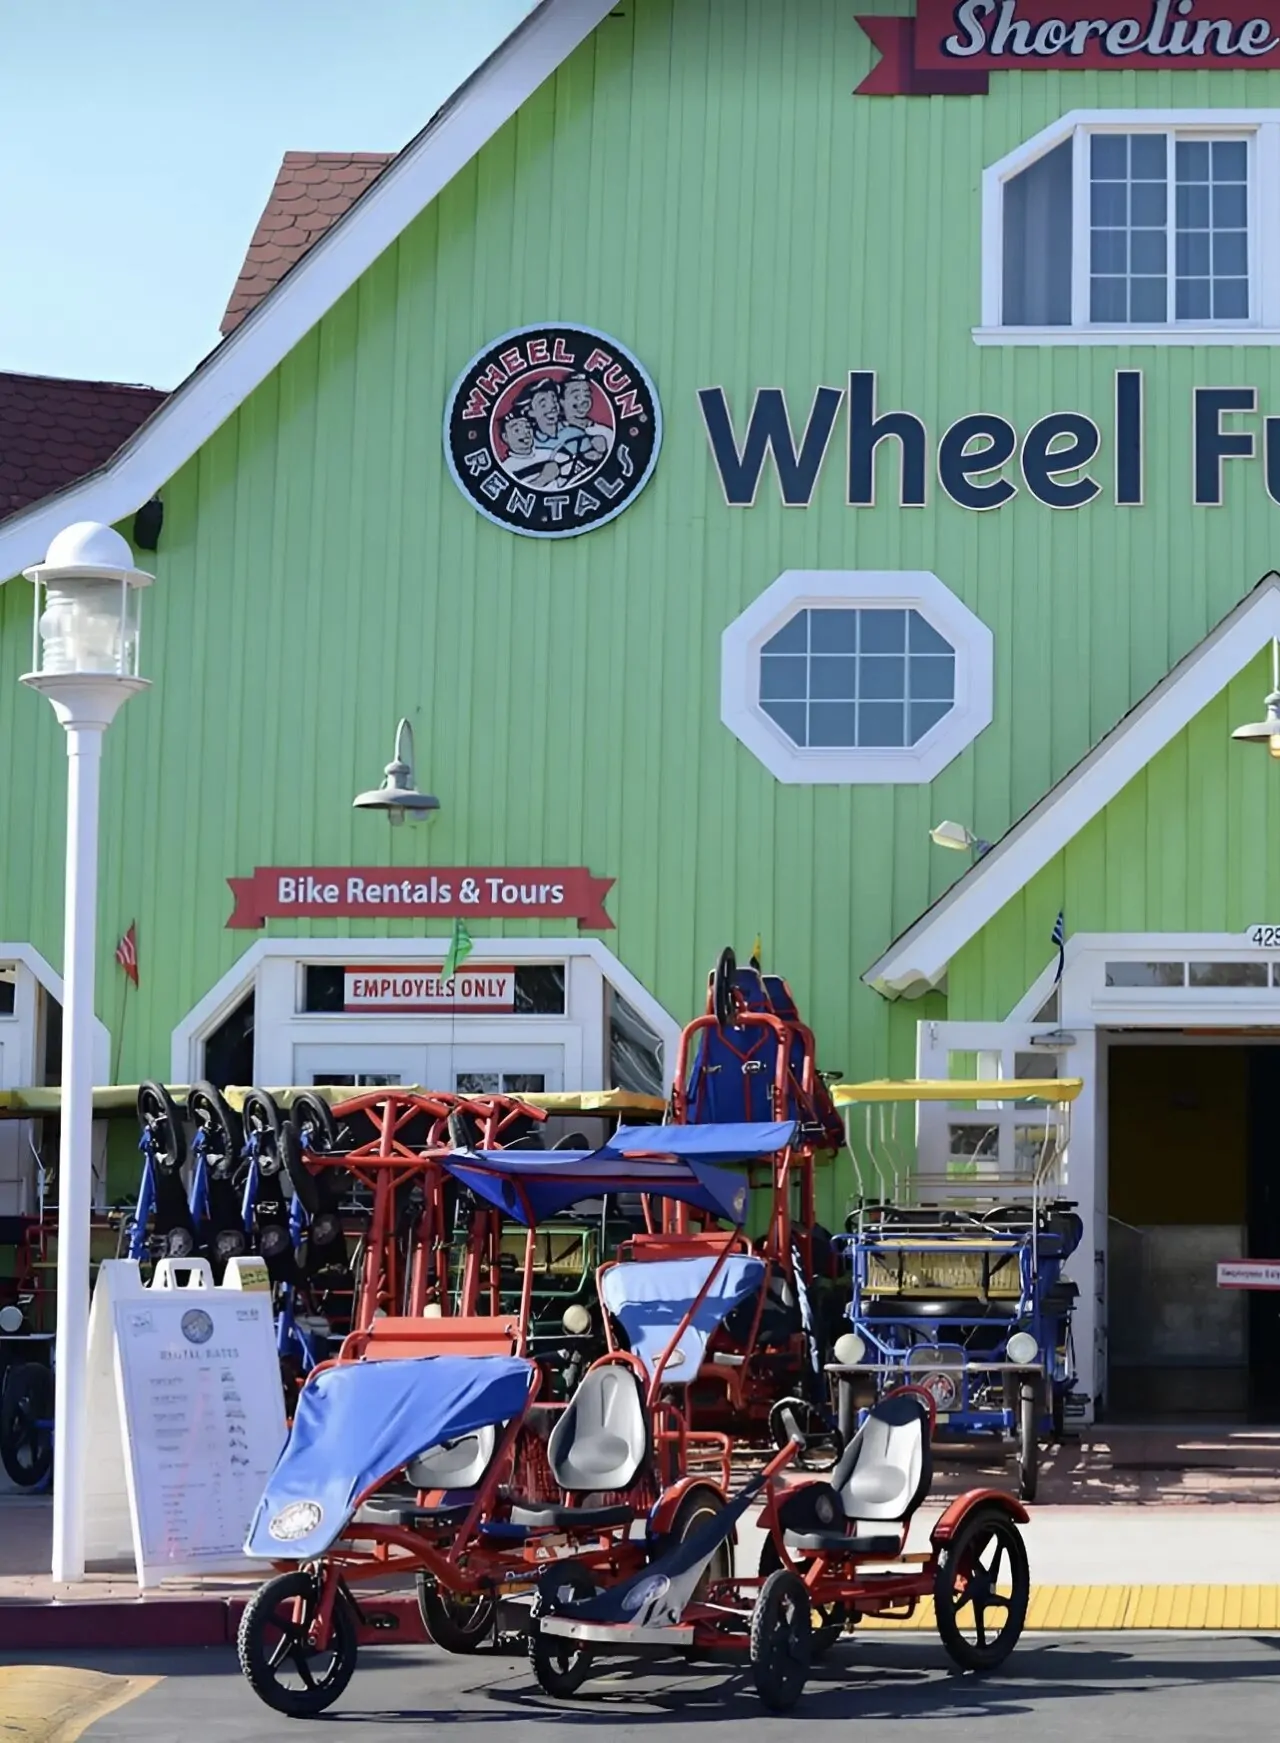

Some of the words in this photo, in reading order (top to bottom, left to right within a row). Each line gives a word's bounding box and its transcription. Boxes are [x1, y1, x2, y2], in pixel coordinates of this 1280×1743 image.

[940, 0, 1280, 58] Shoreline
[462, 337, 575, 420] WHEEL
[583, 348, 643, 419] FUN
[696, 369, 1145, 511] Wheel
[464, 444, 634, 521] RENTALS
[278, 876, 339, 904] Bike
[347, 876, 452, 905] Rentals
[458, 878, 481, 905] &
[486, 878, 564, 905] Tours
[353, 979, 455, 998] EMPLOYEES
[461, 979, 506, 998] ONLY
